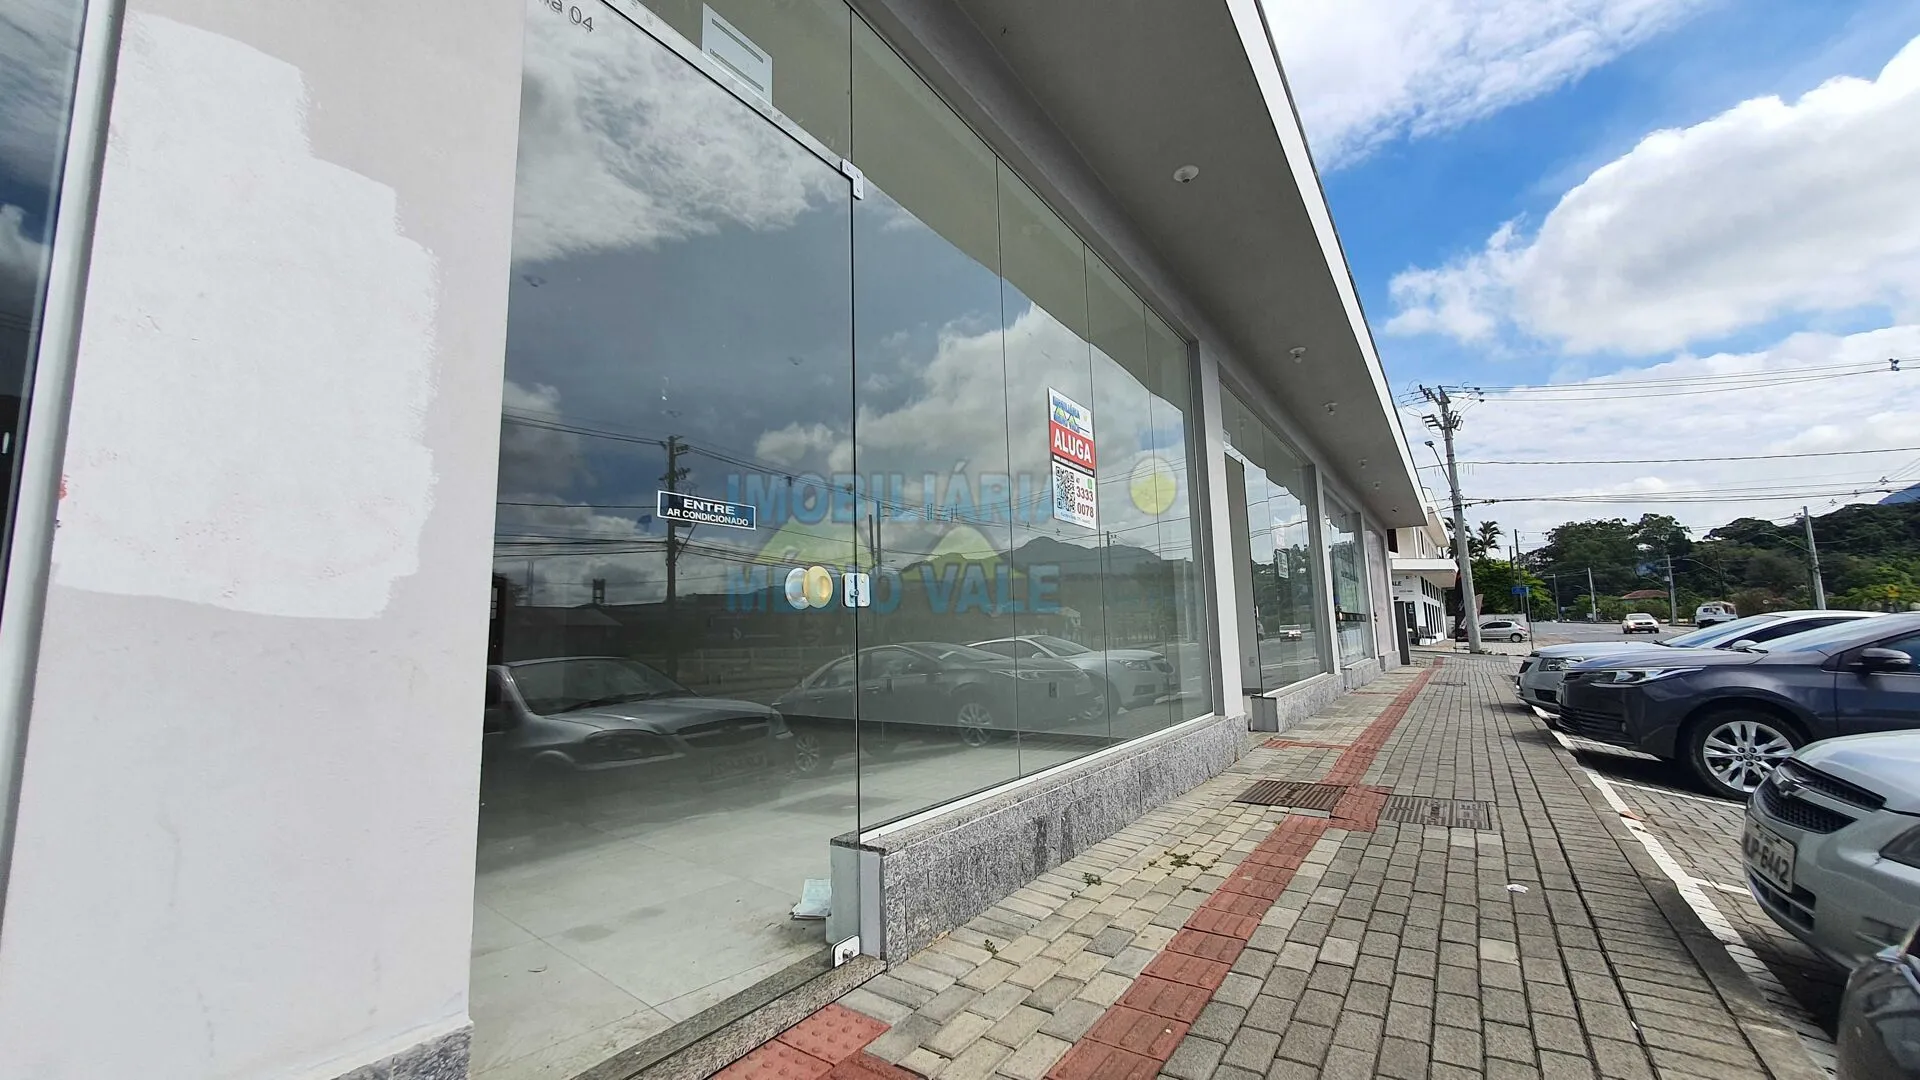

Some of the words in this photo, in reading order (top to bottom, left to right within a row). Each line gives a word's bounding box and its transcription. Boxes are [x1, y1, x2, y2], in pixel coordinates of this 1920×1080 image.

[570, 6, 594, 33] 04
[1054, 428, 1093, 464] ALUGA
[1076, 485, 1094, 502] 3333
[683, 498, 736, 516] ENTRE
[1077, 502, 1095, 518] 0078
[666, 507, 681, 517] AR
[682, 510, 749, 526] CONDICIONADO
